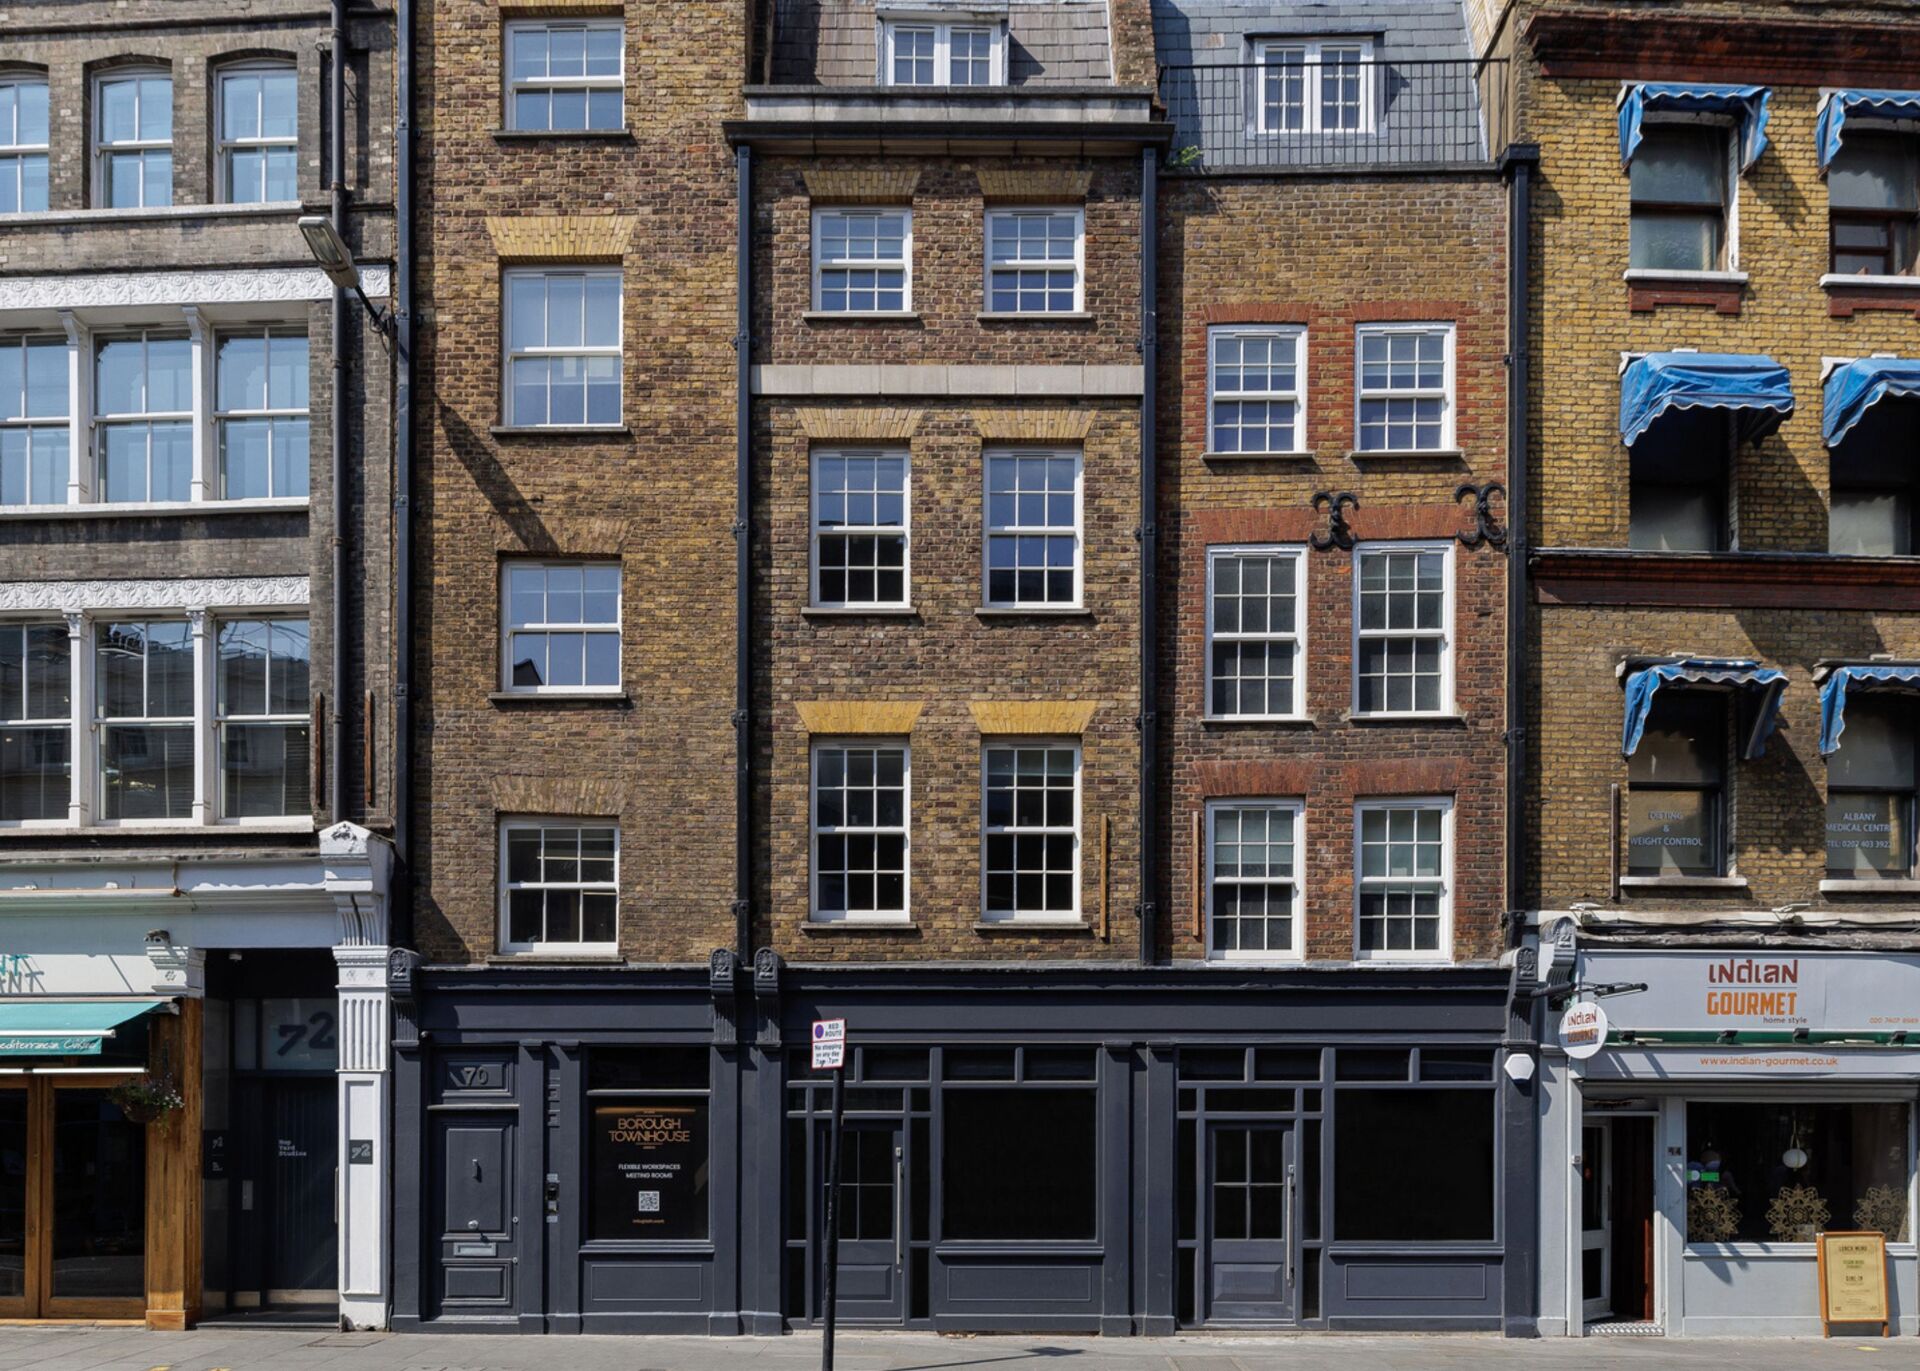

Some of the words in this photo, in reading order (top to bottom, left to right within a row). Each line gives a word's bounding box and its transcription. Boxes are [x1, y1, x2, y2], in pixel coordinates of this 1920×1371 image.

[1843, 812, 1877, 821] ALBANY
[1663, 824, 1670, 833] &
[1825, 823, 1862, 833] MEDICAL
[1863, 823, 1893, 832] CENTR
[1630, 837, 1661, 846] WEIGHT
[1663, 837, 1703, 846] CONTROL
[1707, 992, 1798, 1016] GOURMET
[1762, 1016, 1786, 1024] home
[1788, 1016, 1808, 1025] style
[277, 1010, 336, 1057] 72
[0, 1039, 59, 1050] editerranean
[1700, 1056, 1838, 1067] www.indian-gourmet.co.uk
[618, 1118, 681, 1130] BOROUGH
[608, 1130, 690, 1142] TOWNHOUSE
[351, 1143, 371, 1159] 72
